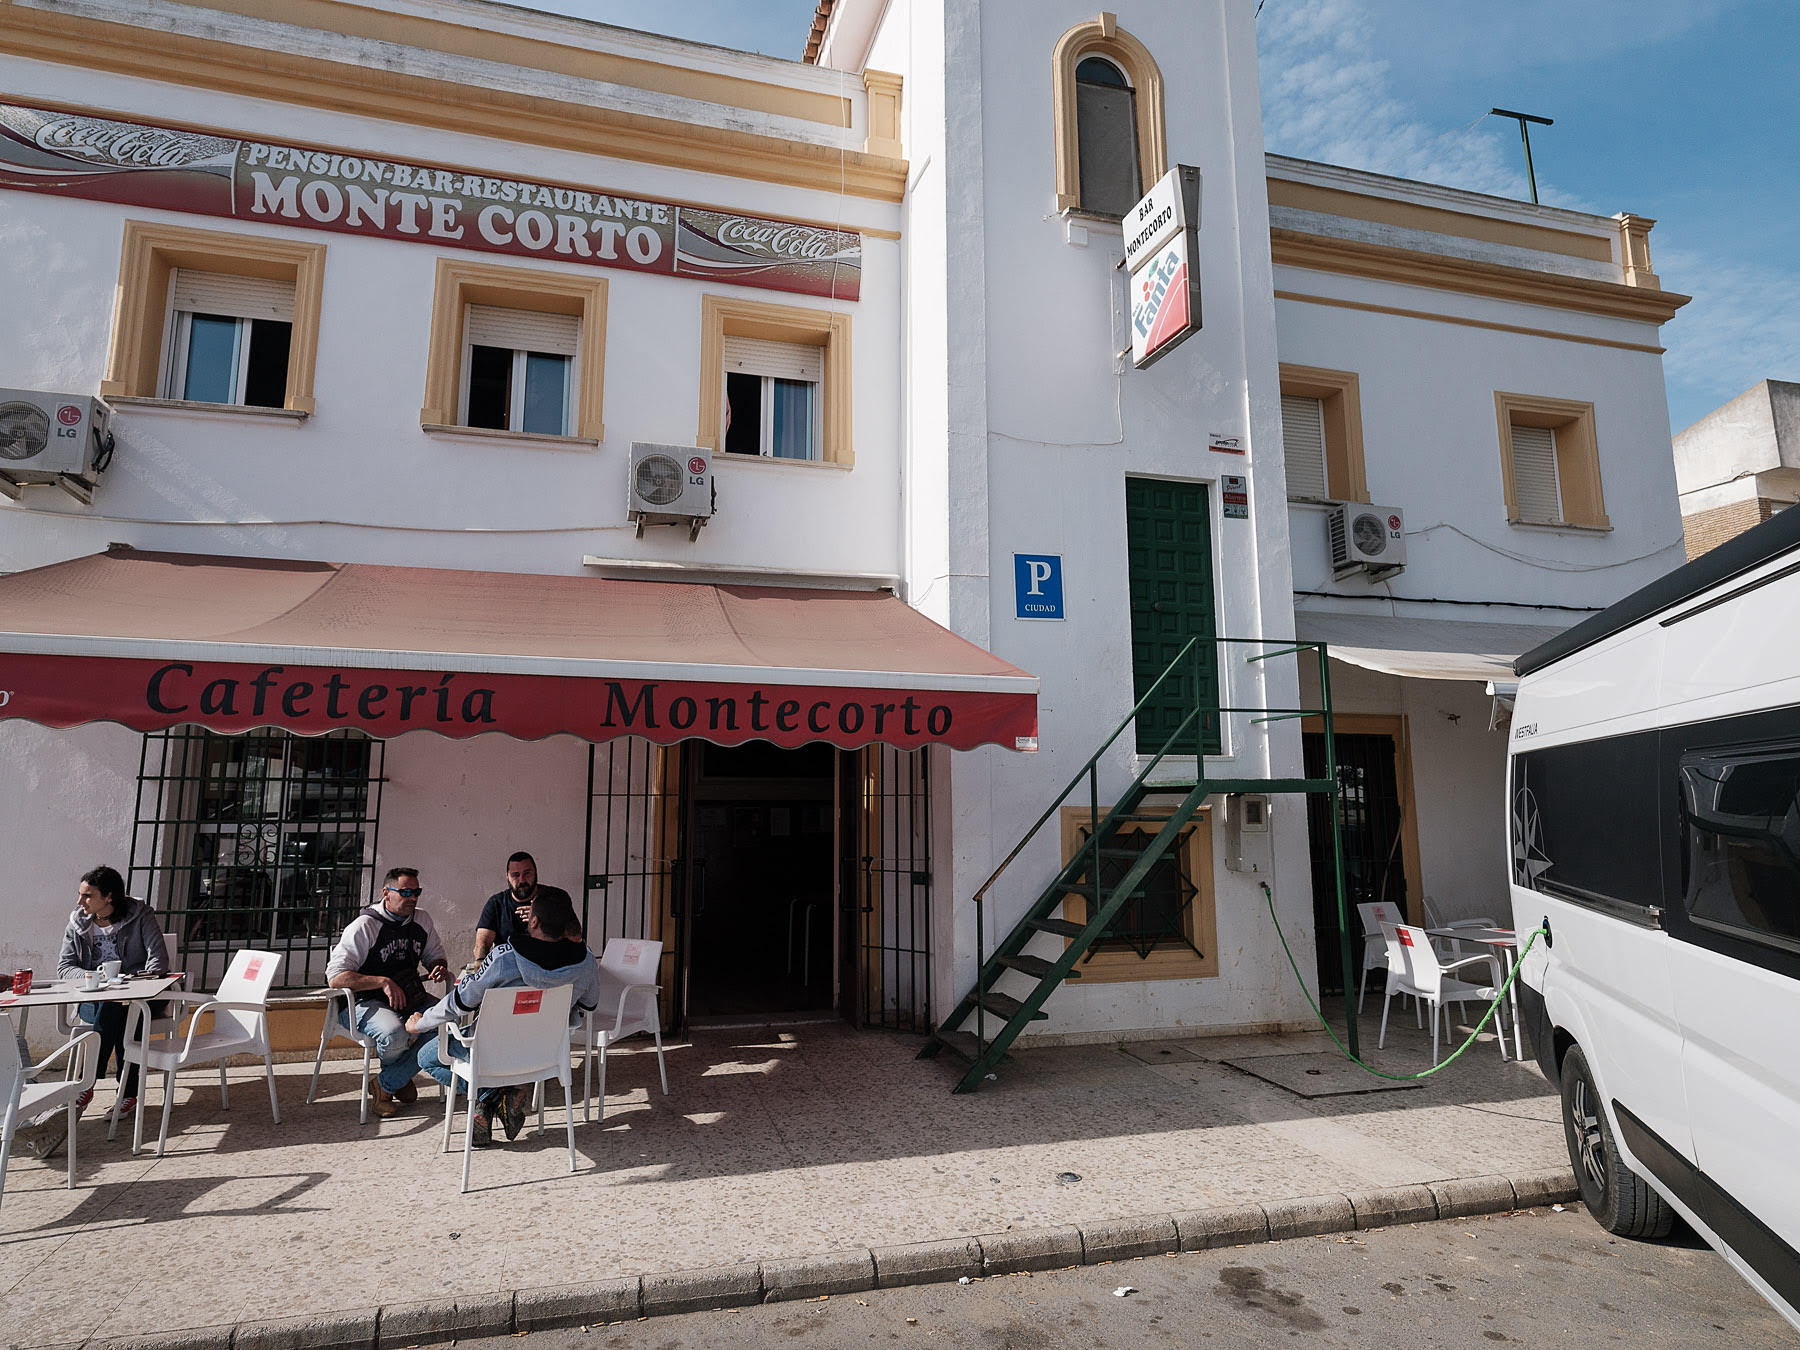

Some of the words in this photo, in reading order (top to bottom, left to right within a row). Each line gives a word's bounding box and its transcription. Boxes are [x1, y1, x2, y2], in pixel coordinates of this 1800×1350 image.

[250, 171, 465, 240] MONTE
[477, 204, 663, 265] CORTO
[1138, 197, 1154, 222] BAR
[1126, 205, 1172, 258] MONTECORTO
[1134, 250, 1180, 338] Fanta
[57, 427, 77, 438] LG
[689, 476, 704, 486] LG
[1390, 531, 1401, 539] LG
[1025, 560, 1052, 595] P
[1024, 603, 1056, 612] CIUDAD
[145, 663, 498, 725] Cafetería
[599, 681, 954, 736] Montecorto
